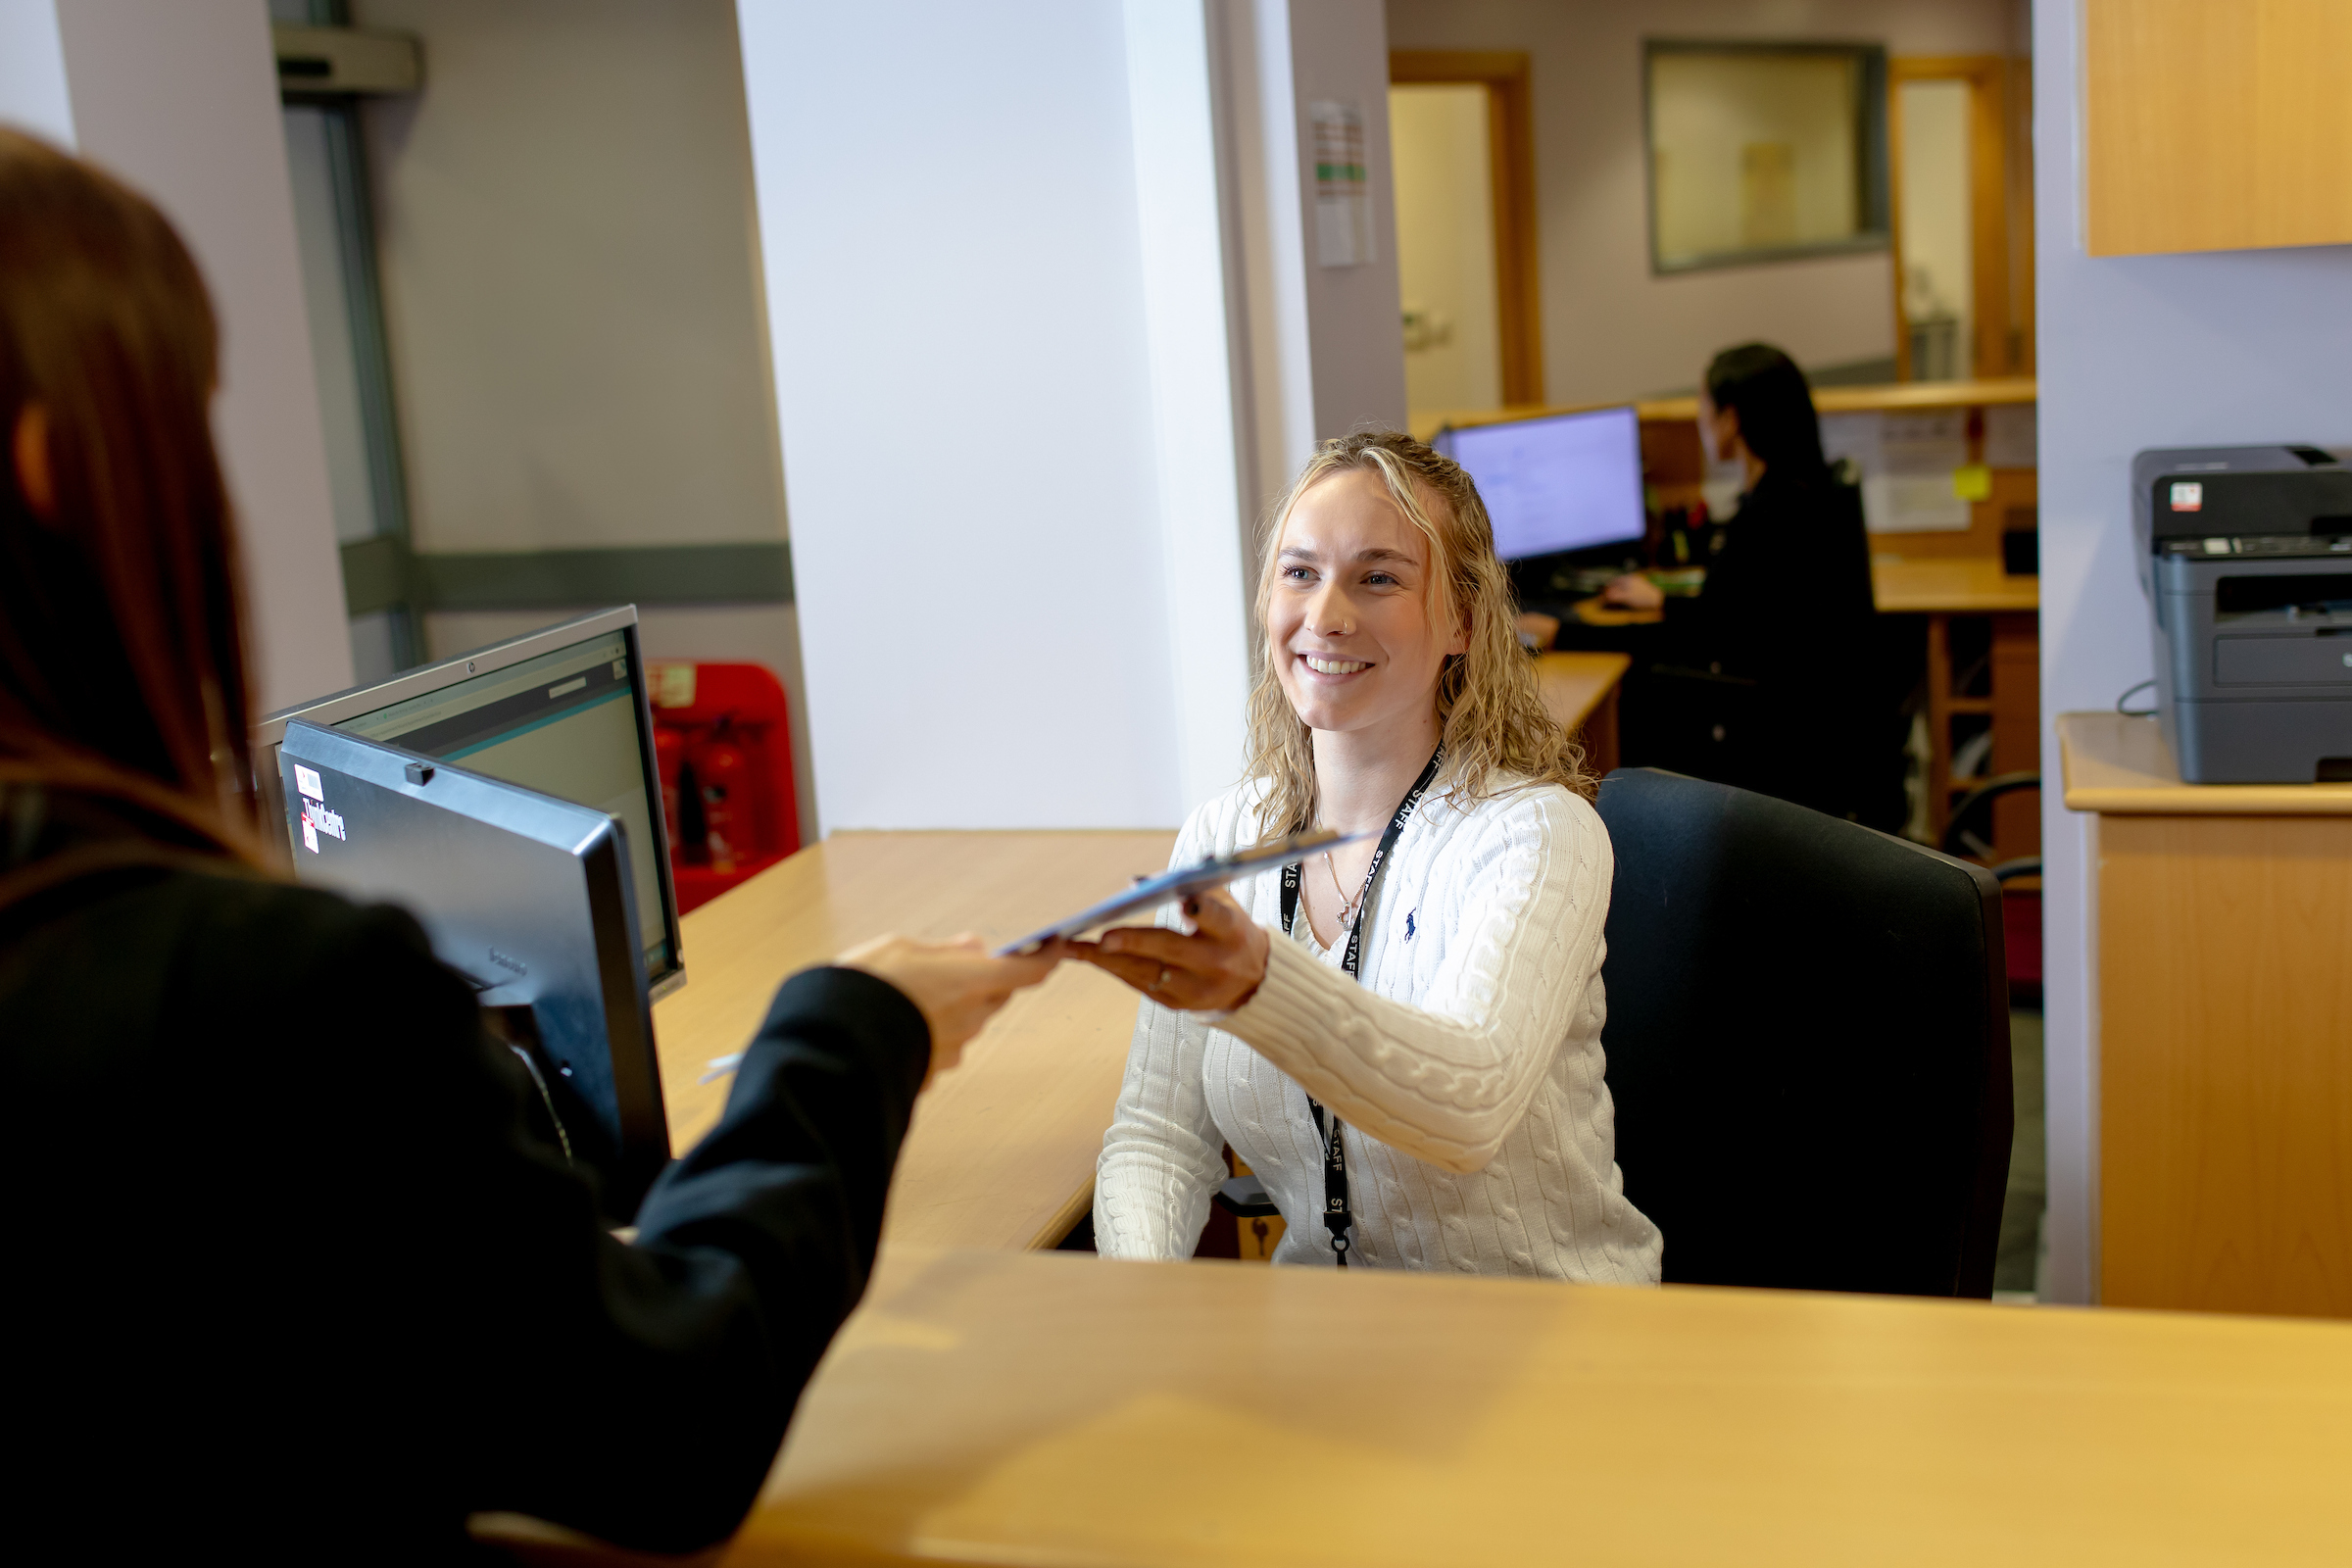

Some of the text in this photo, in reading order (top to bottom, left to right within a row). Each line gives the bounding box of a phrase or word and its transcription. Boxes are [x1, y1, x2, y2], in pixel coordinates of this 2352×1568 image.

[1395, 790, 1423, 830] STAFF
[1285, 862, 1298, 889] STA
[1346, 935, 1358, 979] STAFF
